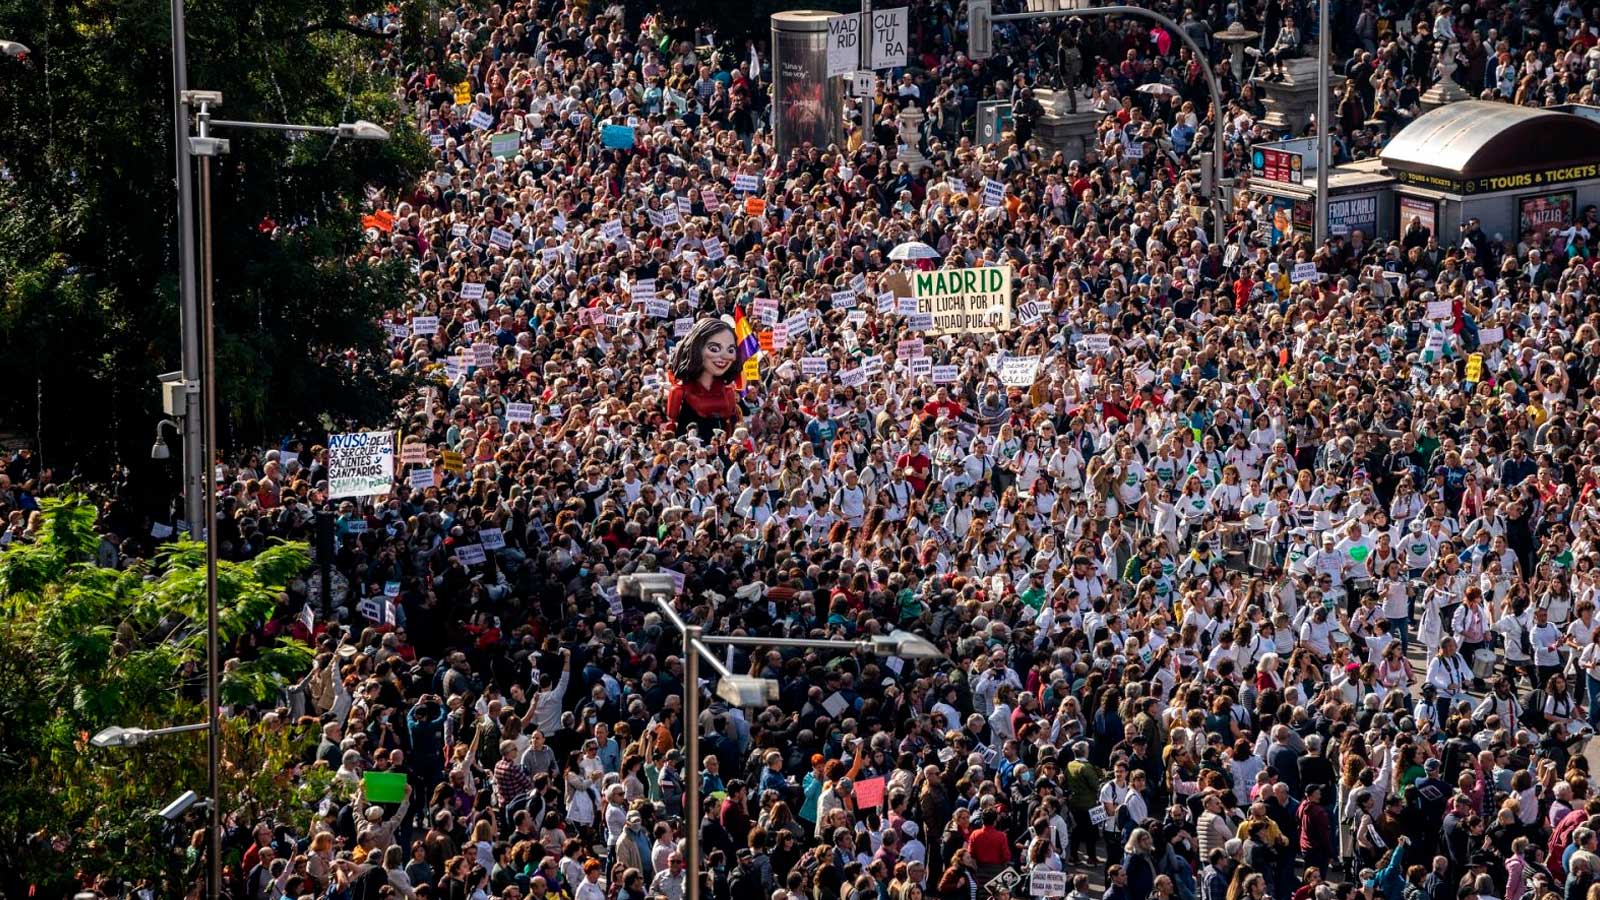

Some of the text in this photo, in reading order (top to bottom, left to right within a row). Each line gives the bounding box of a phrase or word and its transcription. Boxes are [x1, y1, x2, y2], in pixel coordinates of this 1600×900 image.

[828, 18, 858, 35] MAD
[874, 13, 900, 29] CUL
[837, 33, 857, 48] RID
[878, 28, 895, 43] TU
[885, 41, 905, 57] RA
[1408, 172, 1425, 182] TOURS
[1430, 176, 1451, 187] TICKETS
[1490, 164, 1597, 189] TOURS & TICKETS
[1328, 198, 1375, 219] FRIDA KAHLO
[916, 269, 1003, 297] MADRID
[918, 298, 932, 313] EN
[936, 295, 966, 312] LUCHA
[970, 294, 988, 311] POR
[1019, 302, 1039, 321] NO
[329, 433, 392, 448] AYUSO: DEJA
[354, 446, 379, 457] CRUEL
[330, 455, 371, 468] PACIENTES
[329, 464, 383, 479] SANITARIOS
